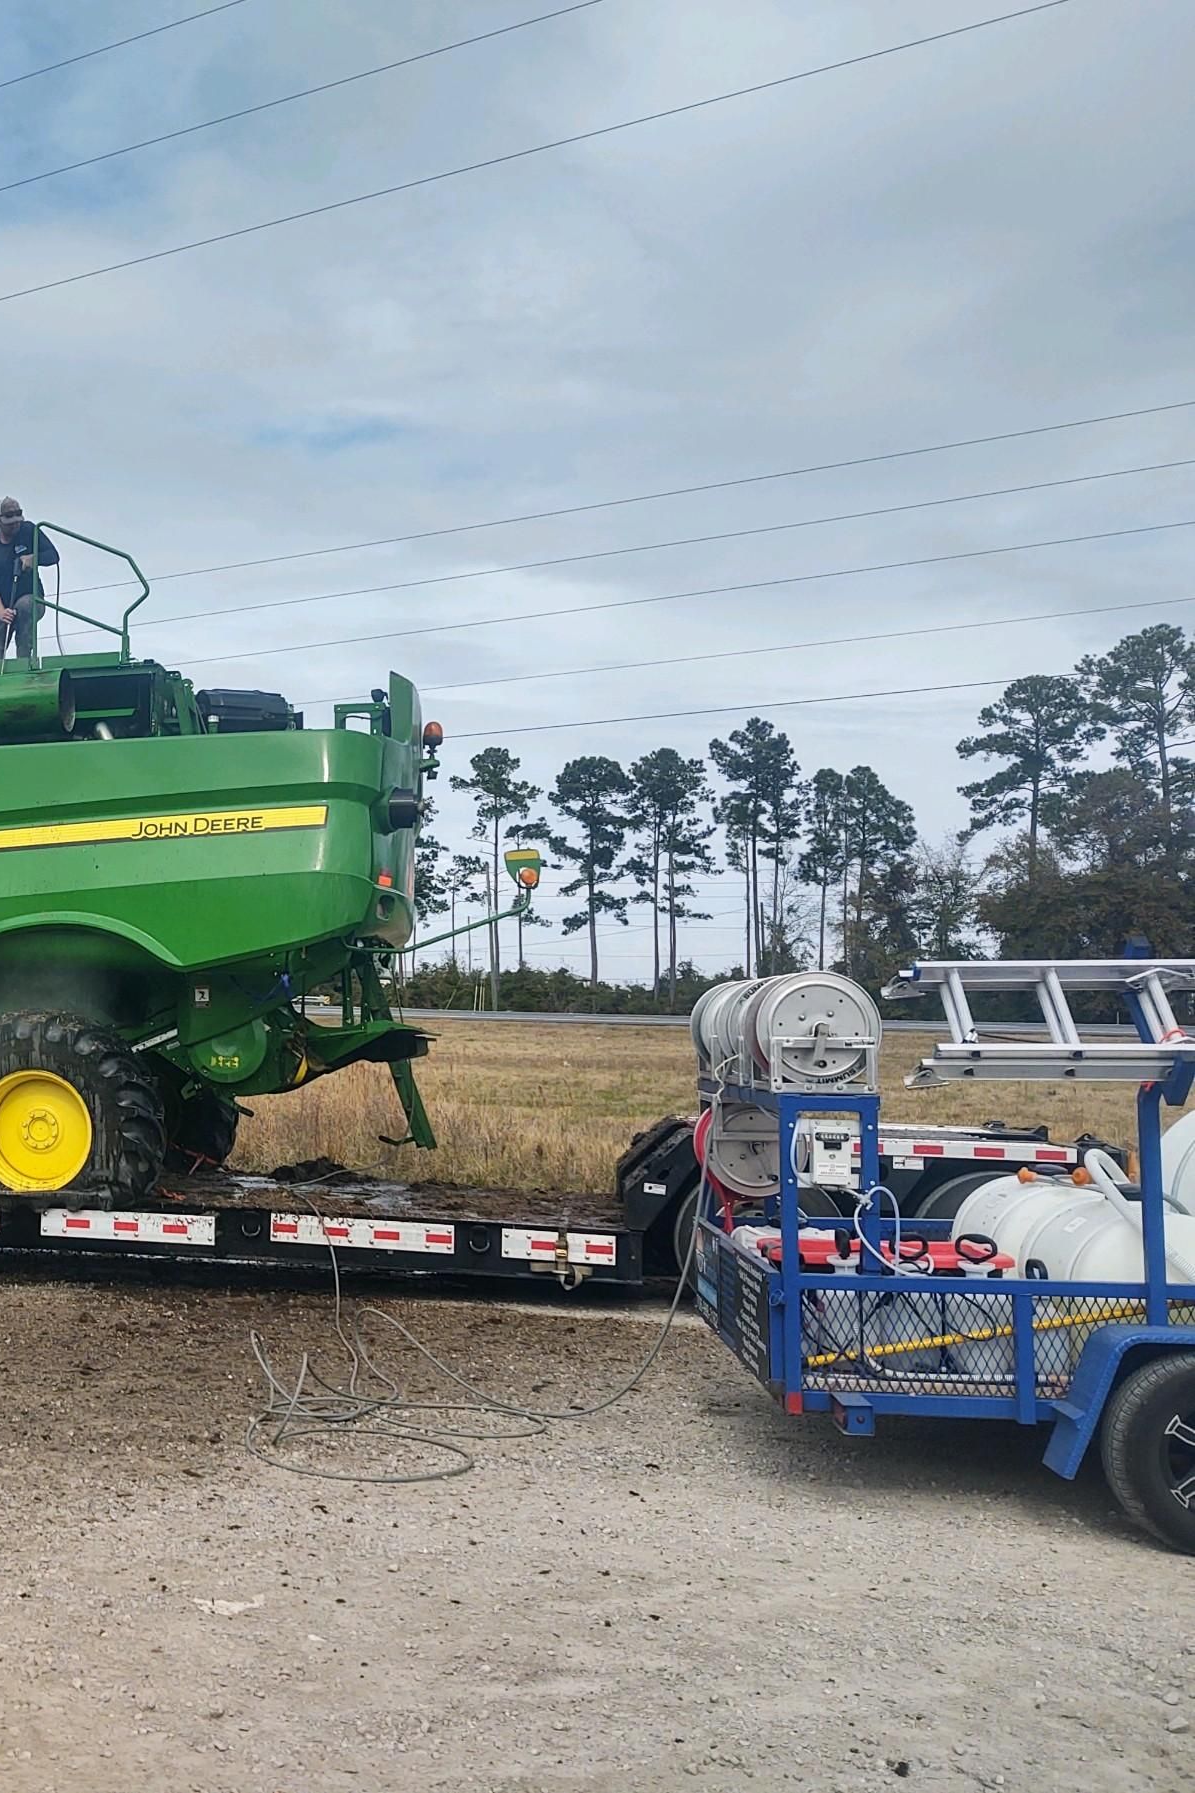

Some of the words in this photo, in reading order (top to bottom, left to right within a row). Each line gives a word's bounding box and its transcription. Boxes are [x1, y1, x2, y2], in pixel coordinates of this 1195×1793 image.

[131, 821, 188, 837] JOHN
[194, 816, 264, 833] DEERE
[817, 1067, 857, 1085] SUMMIT
